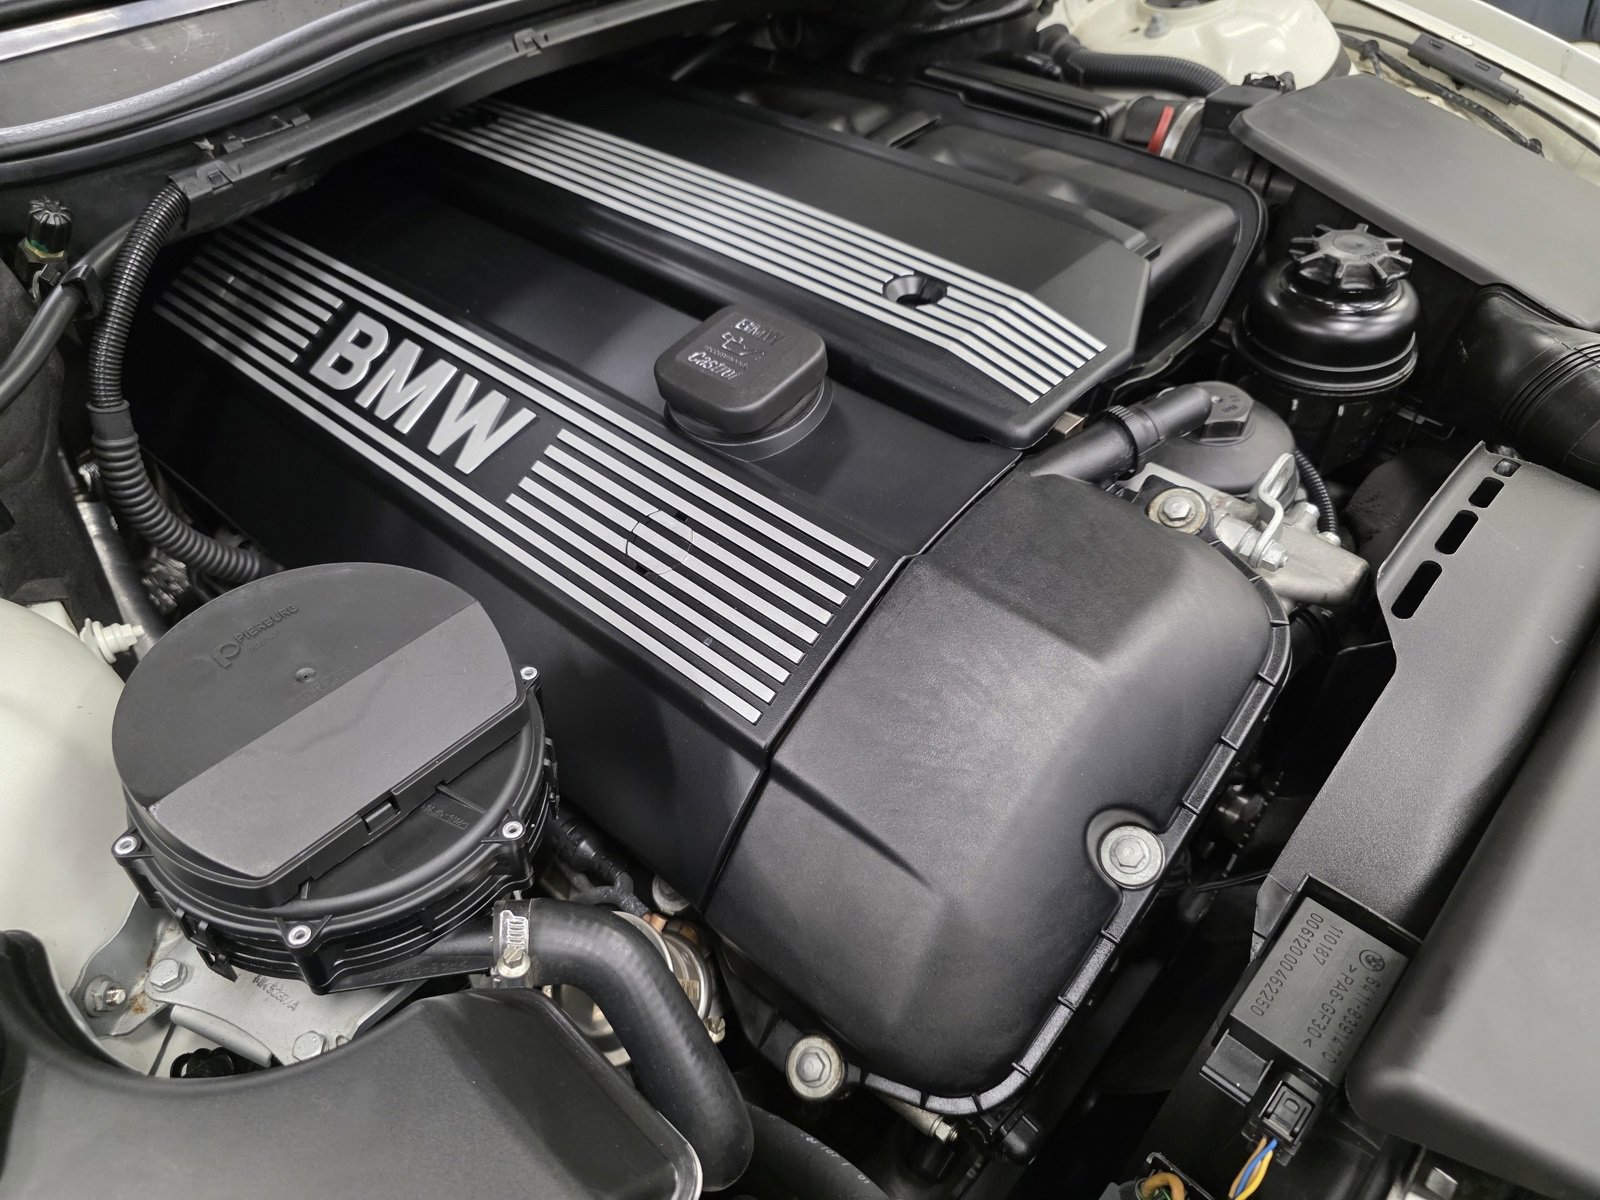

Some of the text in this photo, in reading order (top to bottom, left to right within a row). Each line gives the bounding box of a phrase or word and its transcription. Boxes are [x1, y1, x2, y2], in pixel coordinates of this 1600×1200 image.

[309, 311, 537, 475] BMW
[232, 604, 299, 644] PIERBURG
[1250, 912, 1324, 1017] 00612000462250
[1312, 924, 1344, 966] 110187
[1303, 964, 1358, 1048] >PA6-GF30<
